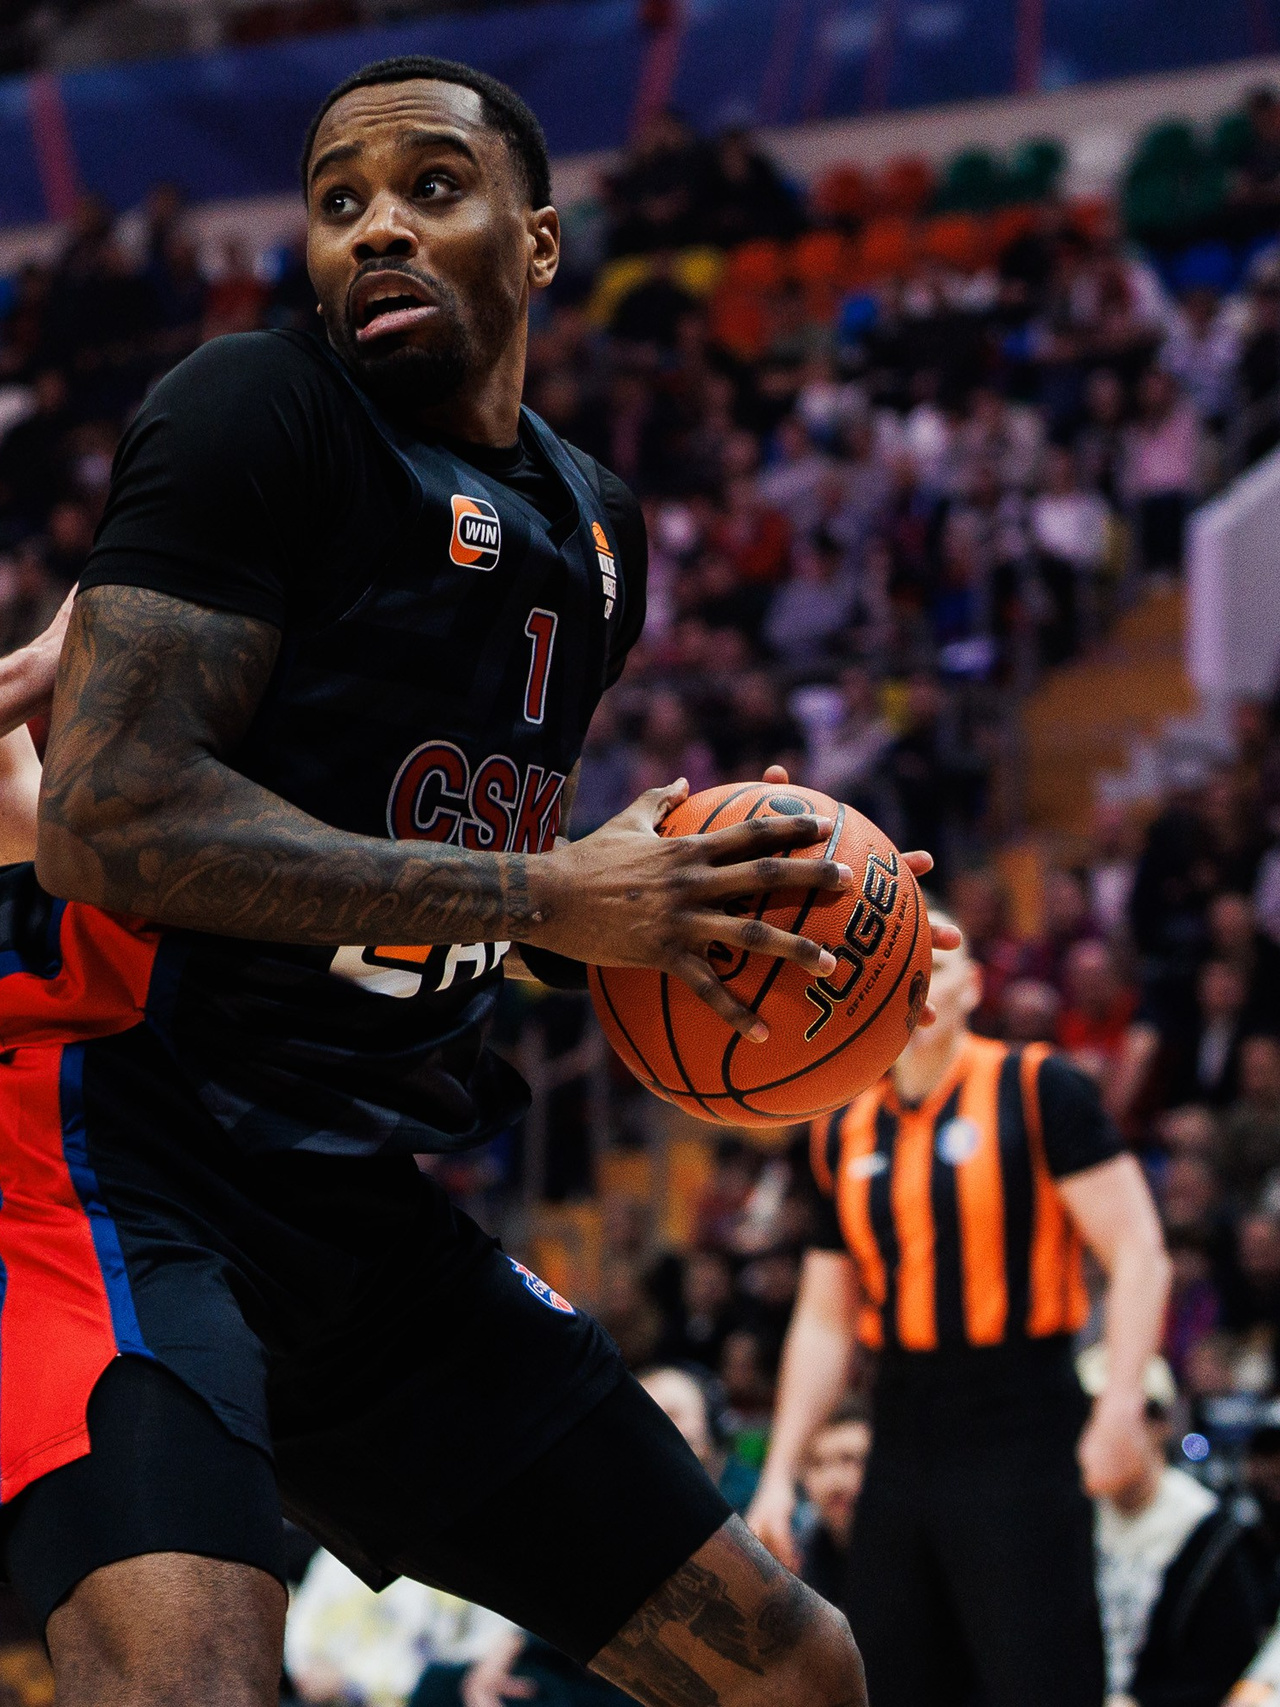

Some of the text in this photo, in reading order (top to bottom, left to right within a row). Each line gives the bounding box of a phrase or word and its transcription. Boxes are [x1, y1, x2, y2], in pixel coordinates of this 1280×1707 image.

[465, 520, 497, 545] WIN
[525, 607, 558, 724] 1
[846, 961, 888, 1018] OFFICIAL
